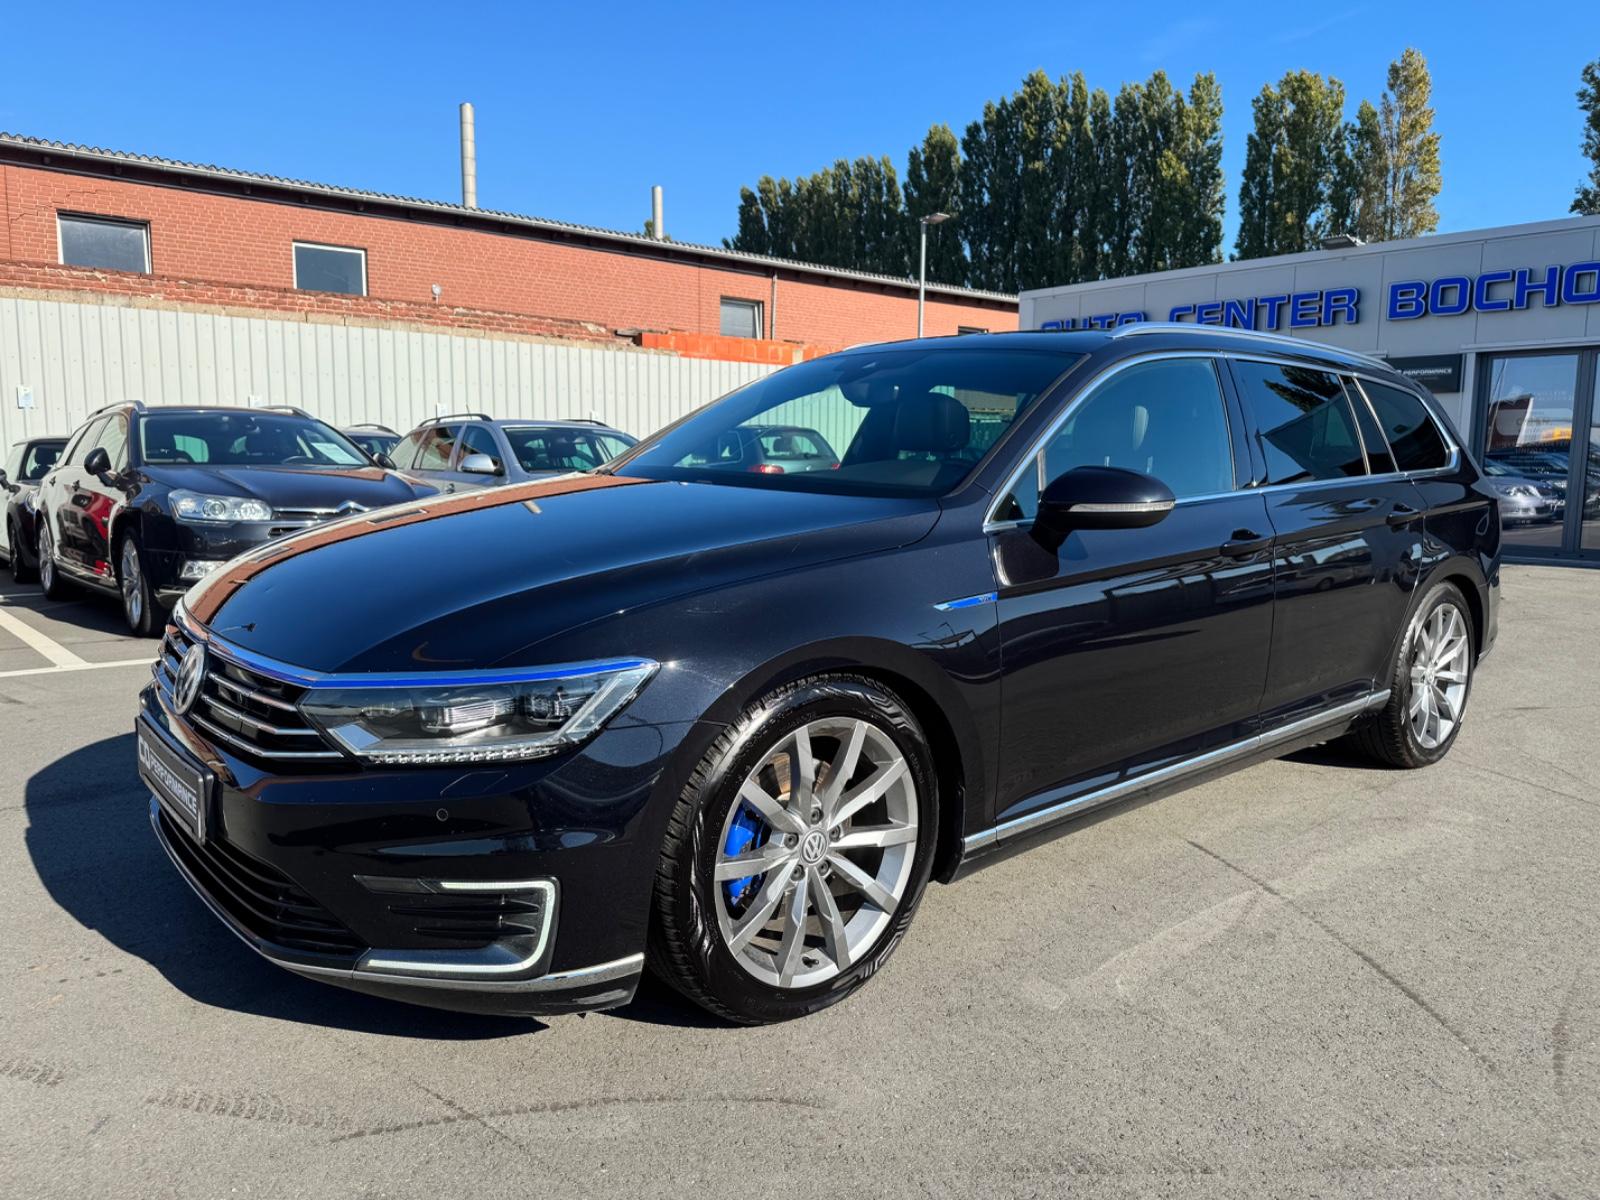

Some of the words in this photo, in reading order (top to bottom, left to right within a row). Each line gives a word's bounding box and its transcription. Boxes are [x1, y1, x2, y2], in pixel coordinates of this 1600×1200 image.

[1169, 287, 1360, 331] CENTER
[1387, 260, 1600, 321] BOCHO
[150, 753, 197, 815] PERFORMANCE
